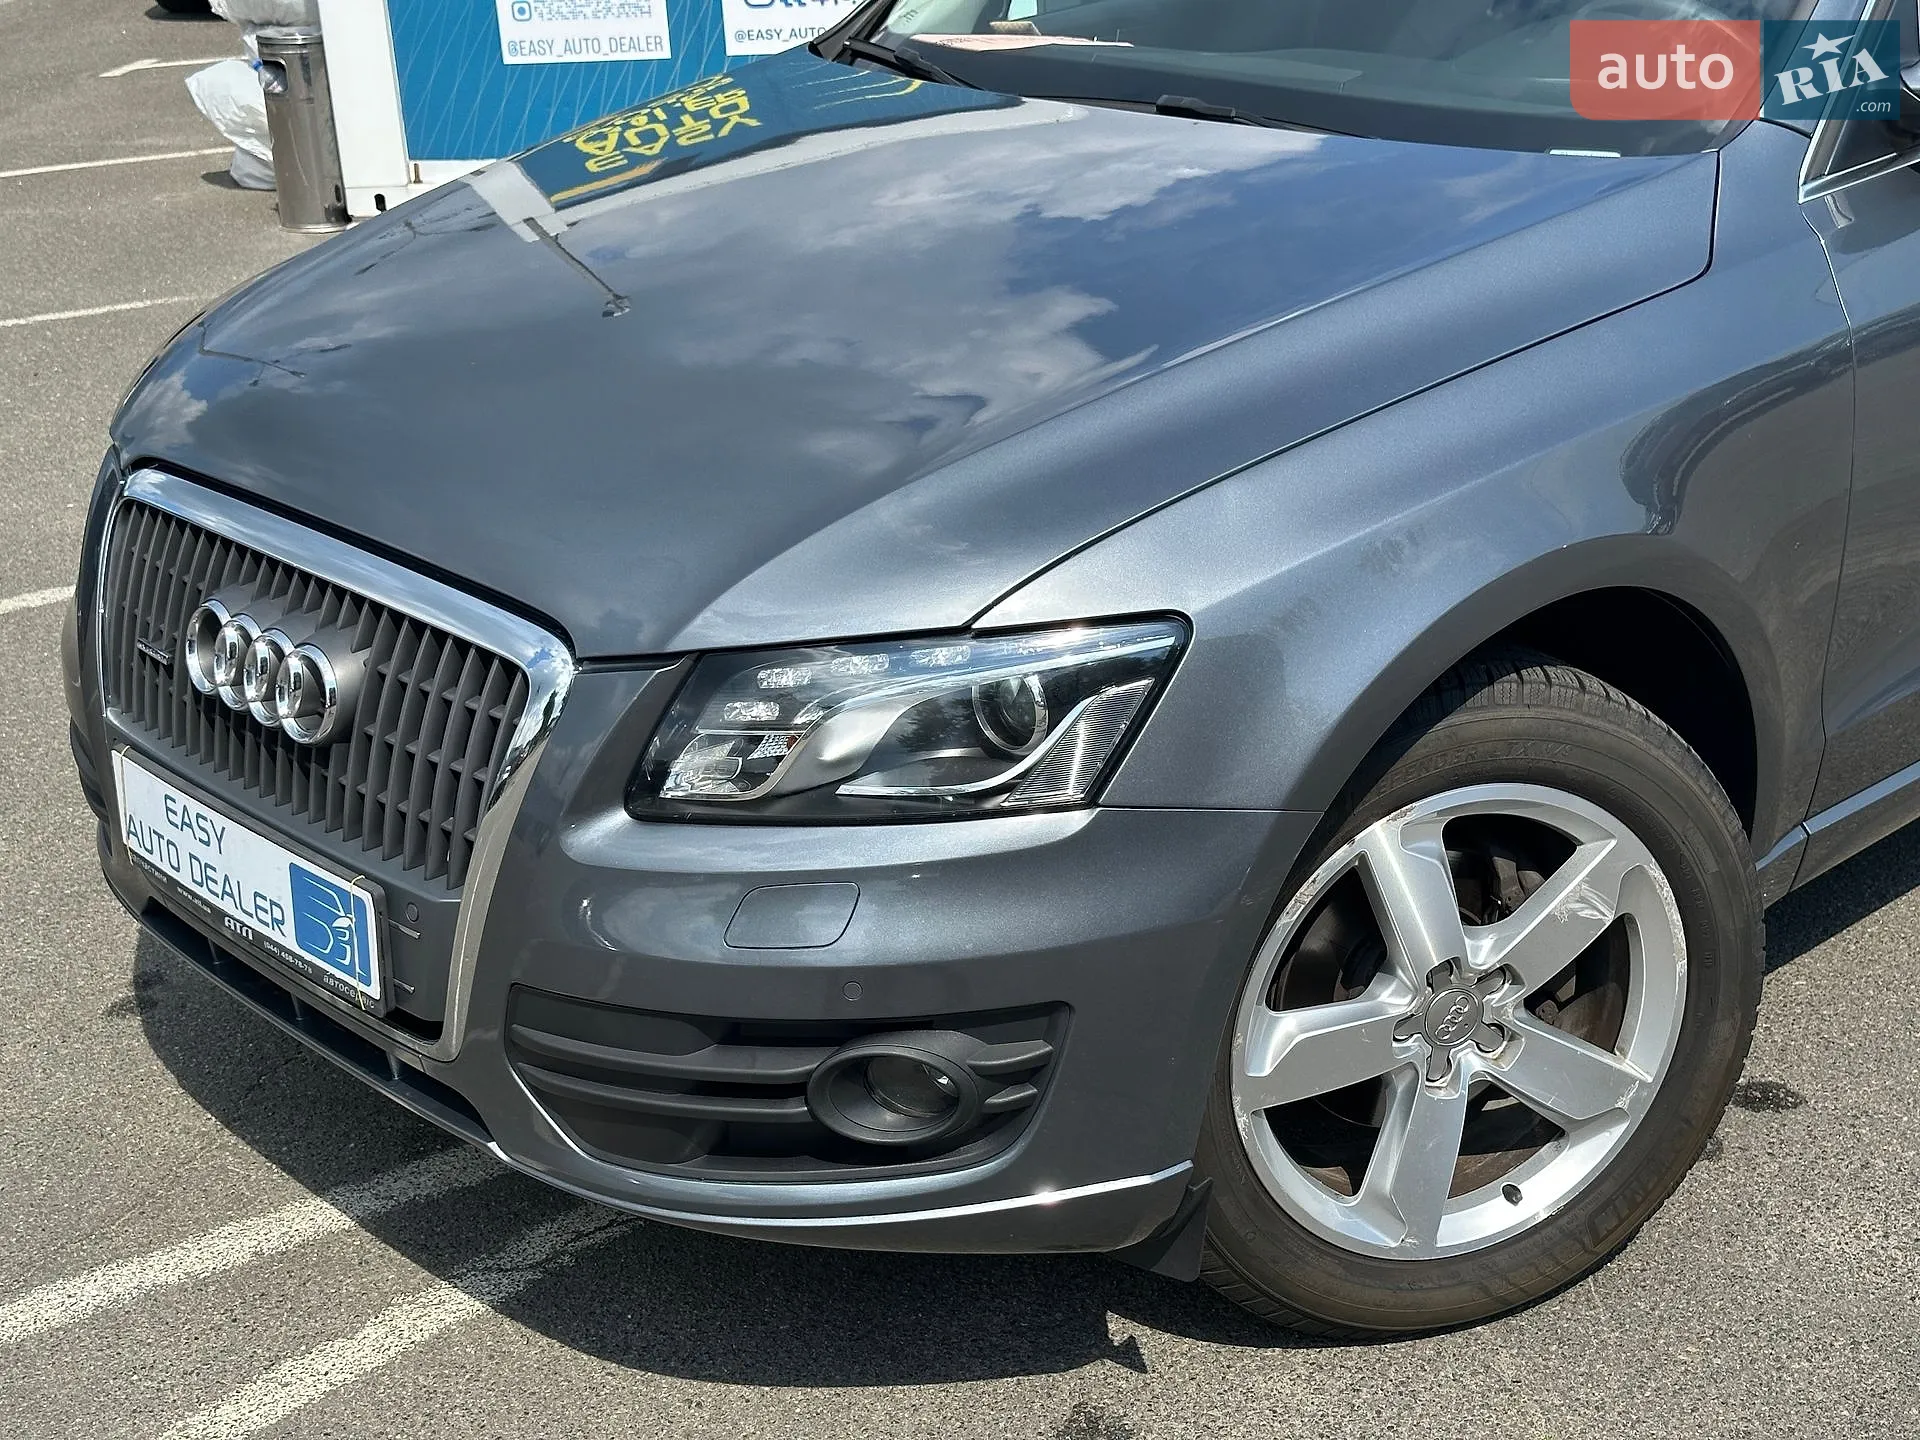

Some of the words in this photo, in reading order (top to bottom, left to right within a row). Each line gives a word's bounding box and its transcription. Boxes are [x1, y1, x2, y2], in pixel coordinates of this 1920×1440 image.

[508, 36, 663, 57] @EASY_AUTO_DEALER
[164, 793, 226, 854] EASY
[127, 813, 181, 873] AUTO
[188, 851, 287, 938] DEALER
